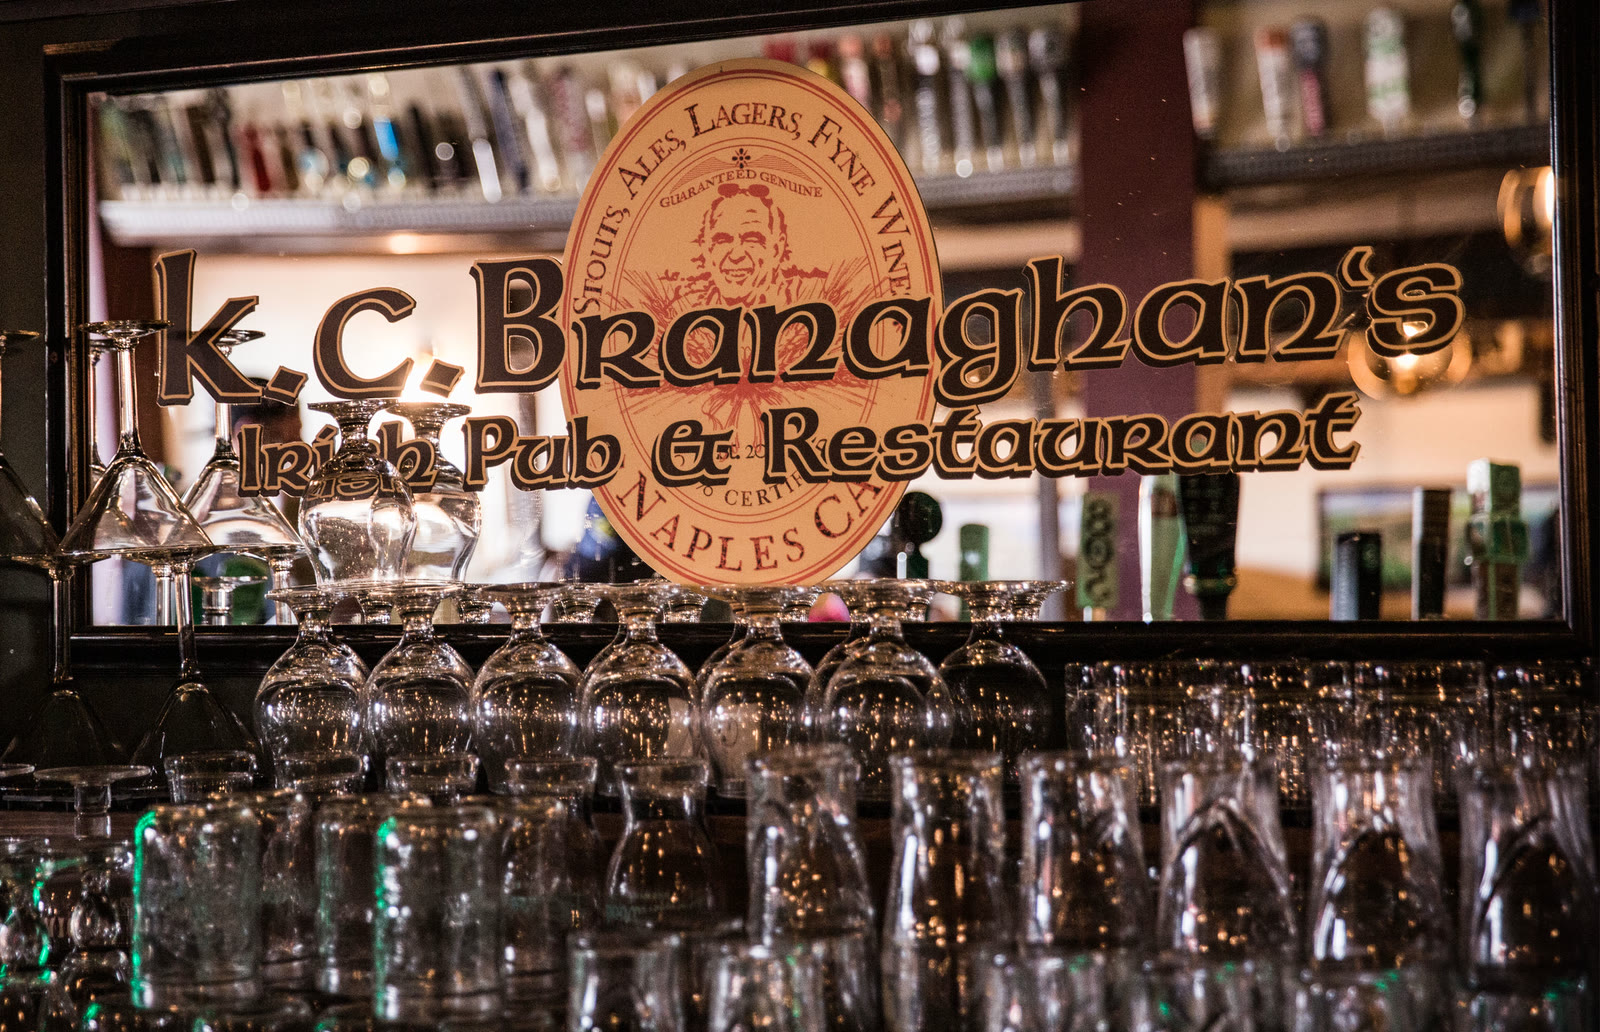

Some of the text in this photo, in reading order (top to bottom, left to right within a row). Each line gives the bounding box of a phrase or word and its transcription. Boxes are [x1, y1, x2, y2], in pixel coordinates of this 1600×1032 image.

[572, 102, 912, 314] STOUTS, ALES, LAGERS, FYNE WINE
[659, 169, 823, 208] GUARANTEED GENUINE
[237, 421, 440, 497] Irih
[462, 416, 624, 491] Pub
[651, 418, 735, 487] &
[760, 392, 1362, 484] Restaurant
[616, 470, 804, 571] NAPLES
[814, 481, 884, 538] CA
